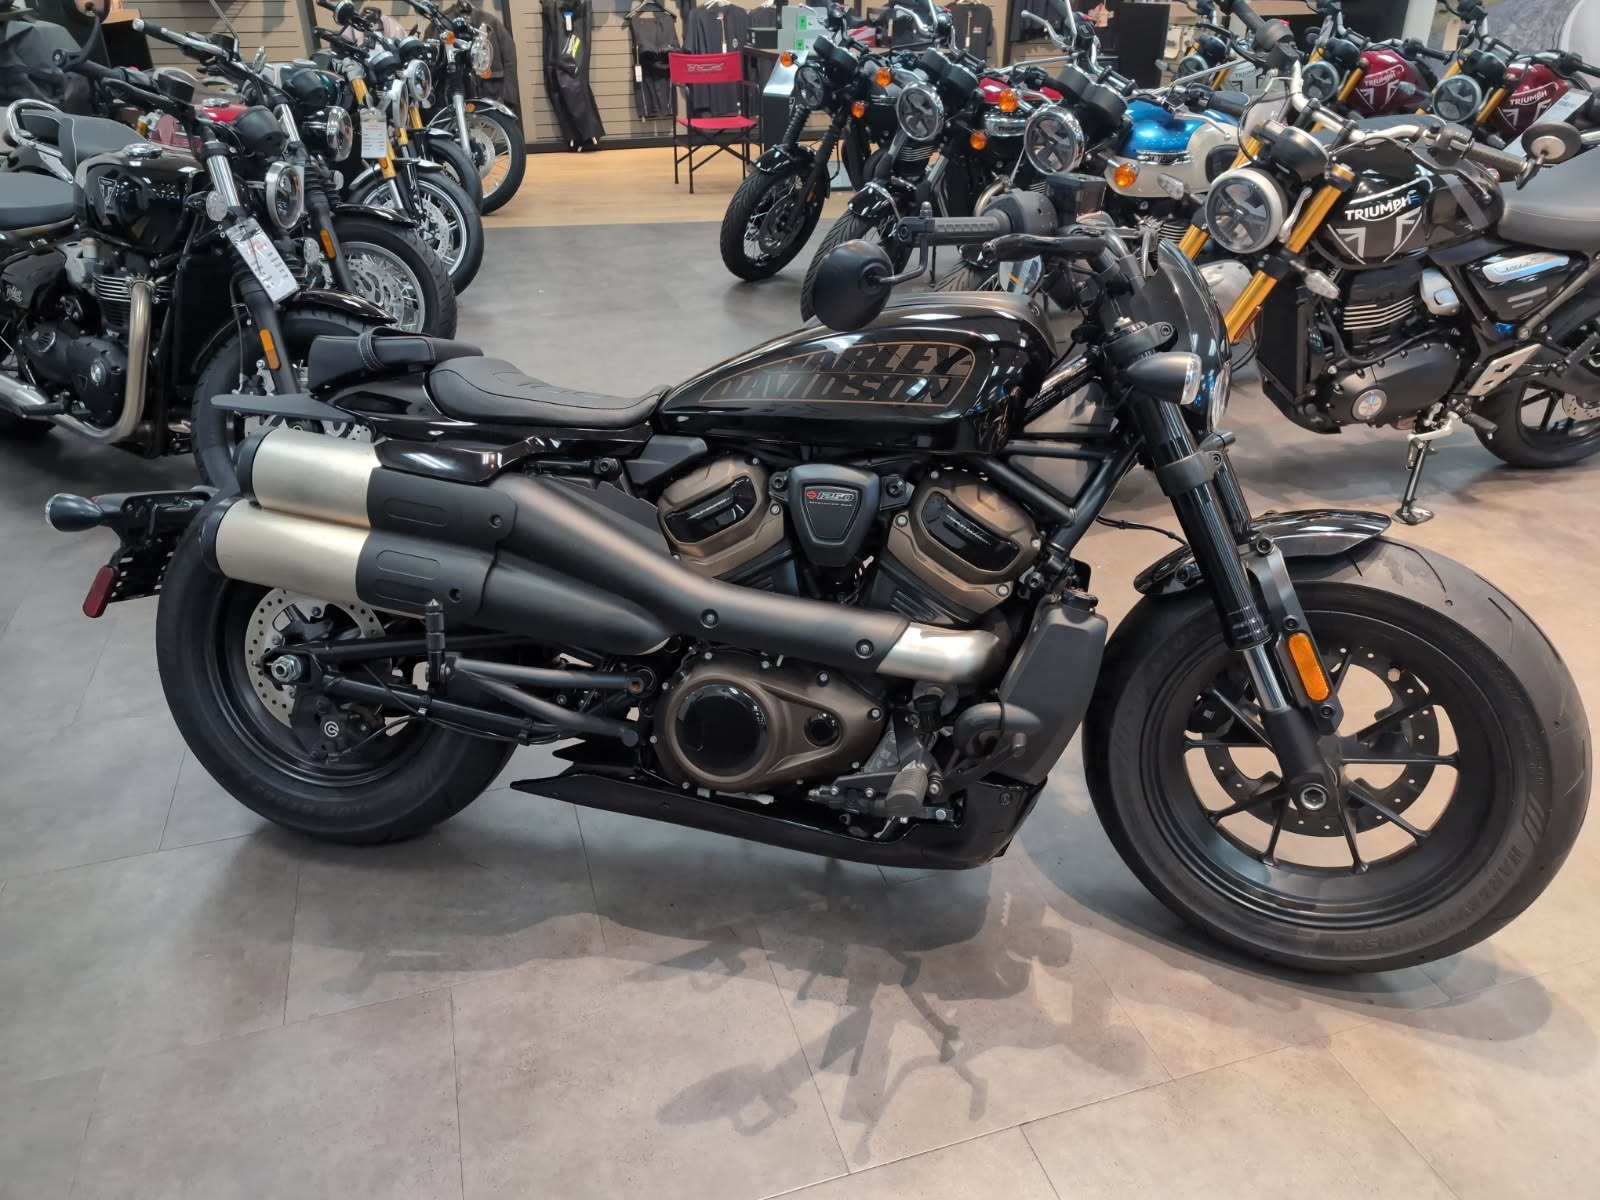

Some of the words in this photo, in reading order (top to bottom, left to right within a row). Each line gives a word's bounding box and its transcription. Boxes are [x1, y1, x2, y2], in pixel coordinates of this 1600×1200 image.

[1364, 70, 1397, 87] TRIUMPH
[1509, 89, 1548, 106] TRIUMPH
[1344, 193, 1412, 222] TRIUMPH
[816, 491, 855, 502] 1250
